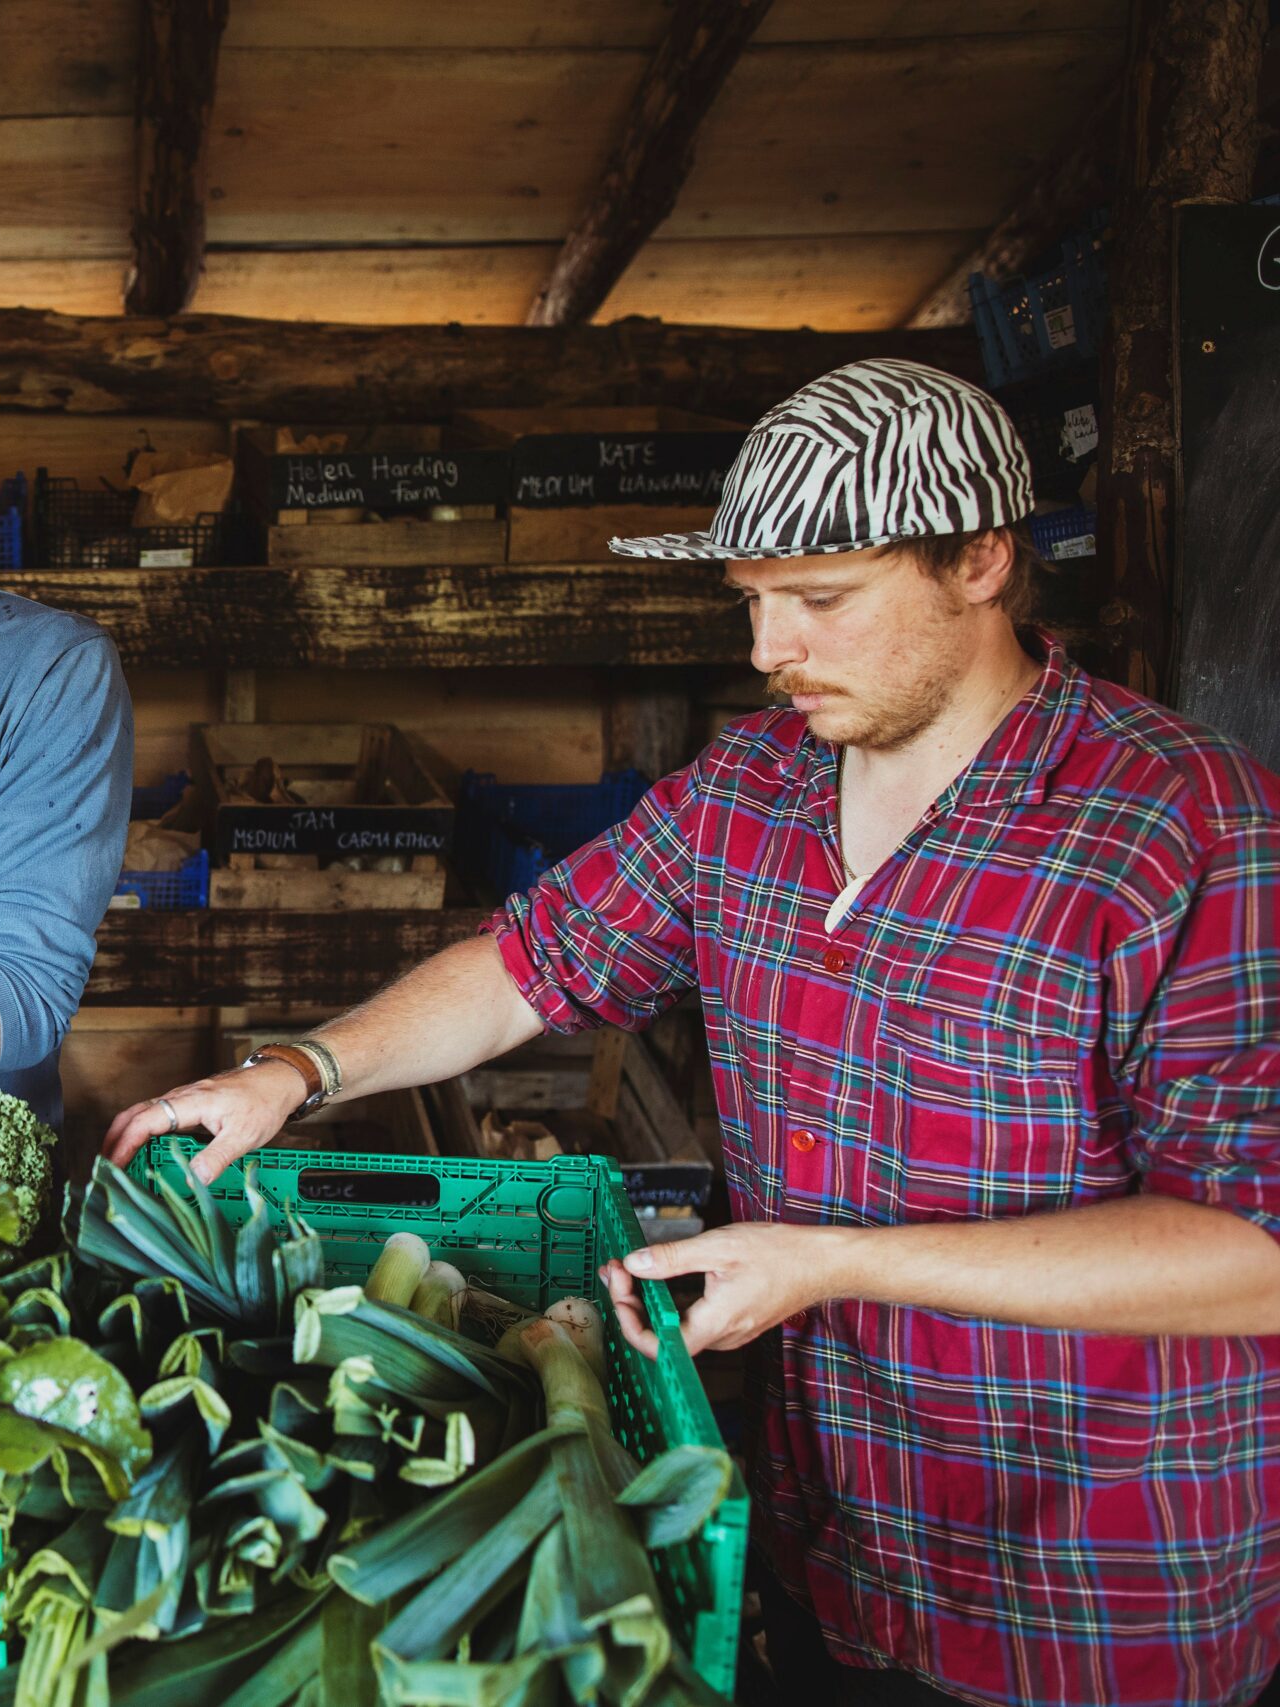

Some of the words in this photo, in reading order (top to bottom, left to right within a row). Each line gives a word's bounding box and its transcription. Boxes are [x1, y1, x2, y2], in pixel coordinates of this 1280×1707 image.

[287, 458, 356, 483] Helen
[371, 456, 459, 488] Harding
[285, 483, 365, 506] Medium
[389, 480, 443, 504] Farm
[289, 811, 335, 830] JAM
[233, 828, 297, 850] MEDIUM
